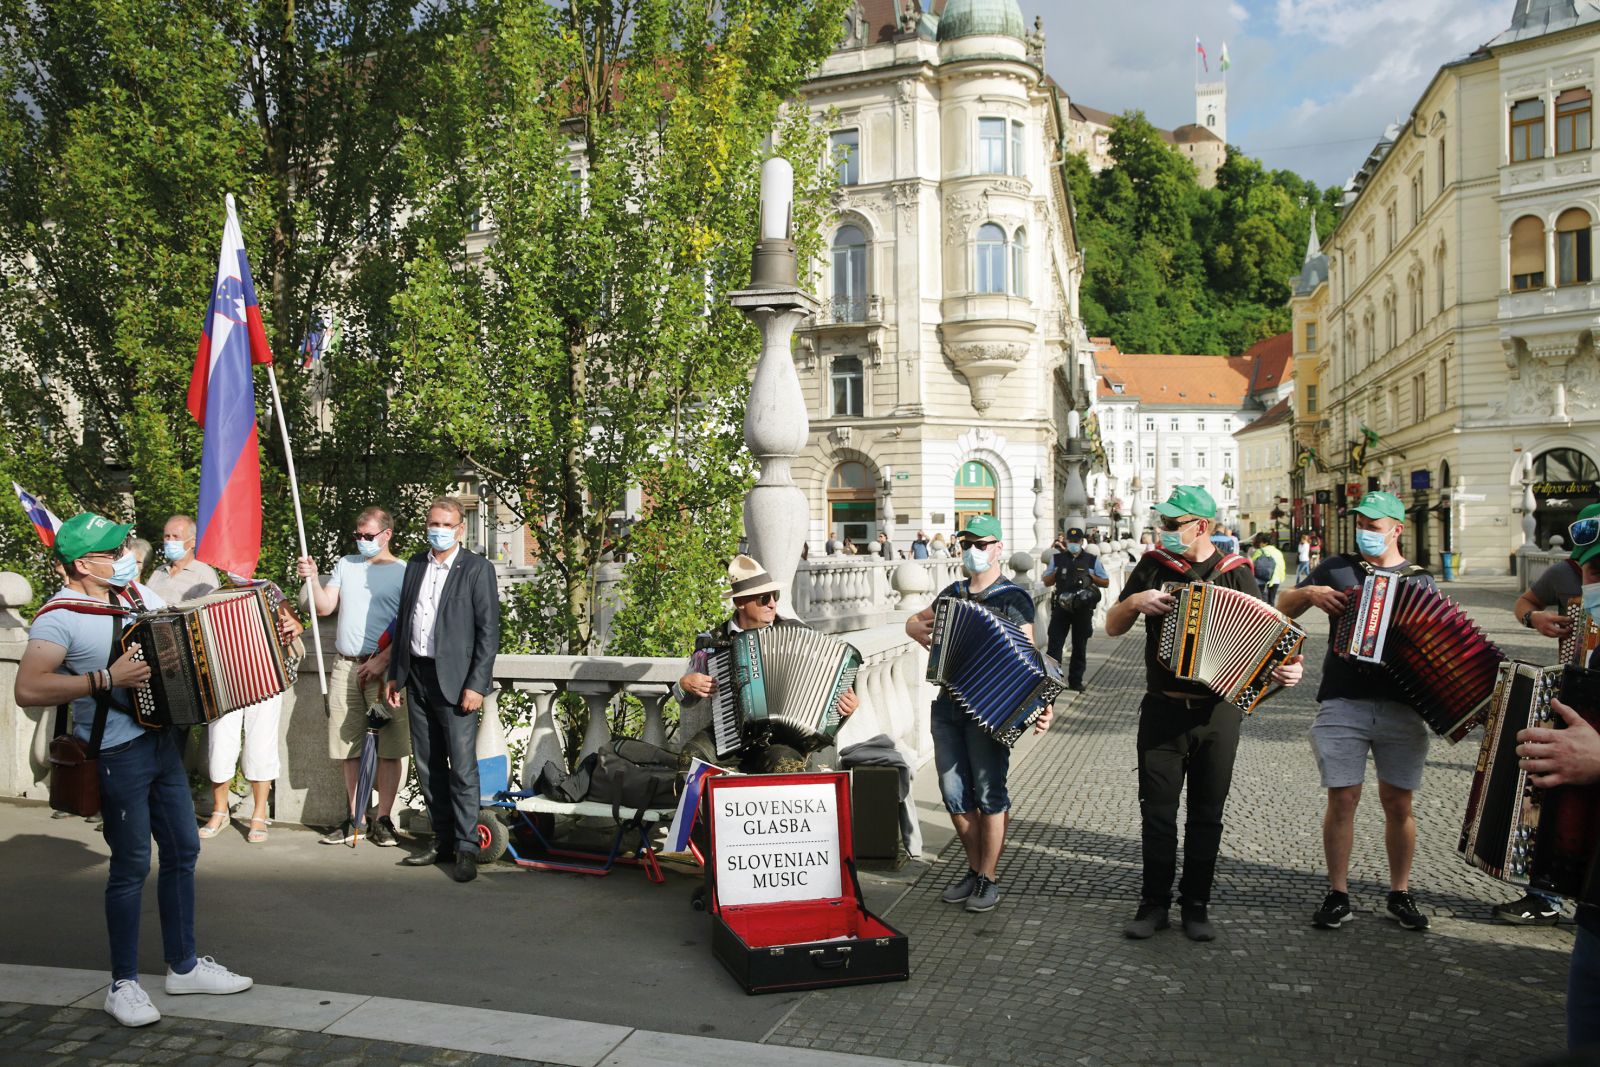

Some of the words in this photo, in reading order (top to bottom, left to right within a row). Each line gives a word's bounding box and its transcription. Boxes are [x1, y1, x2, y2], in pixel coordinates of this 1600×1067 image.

[747, 634, 760, 679] BELTUNA
[725, 799, 827, 817] SLOVENSKA
[743, 818, 811, 835] GLASBA
[728, 851, 829, 871] SLOVENIAN
[752, 871, 808, 889] MUSIC
